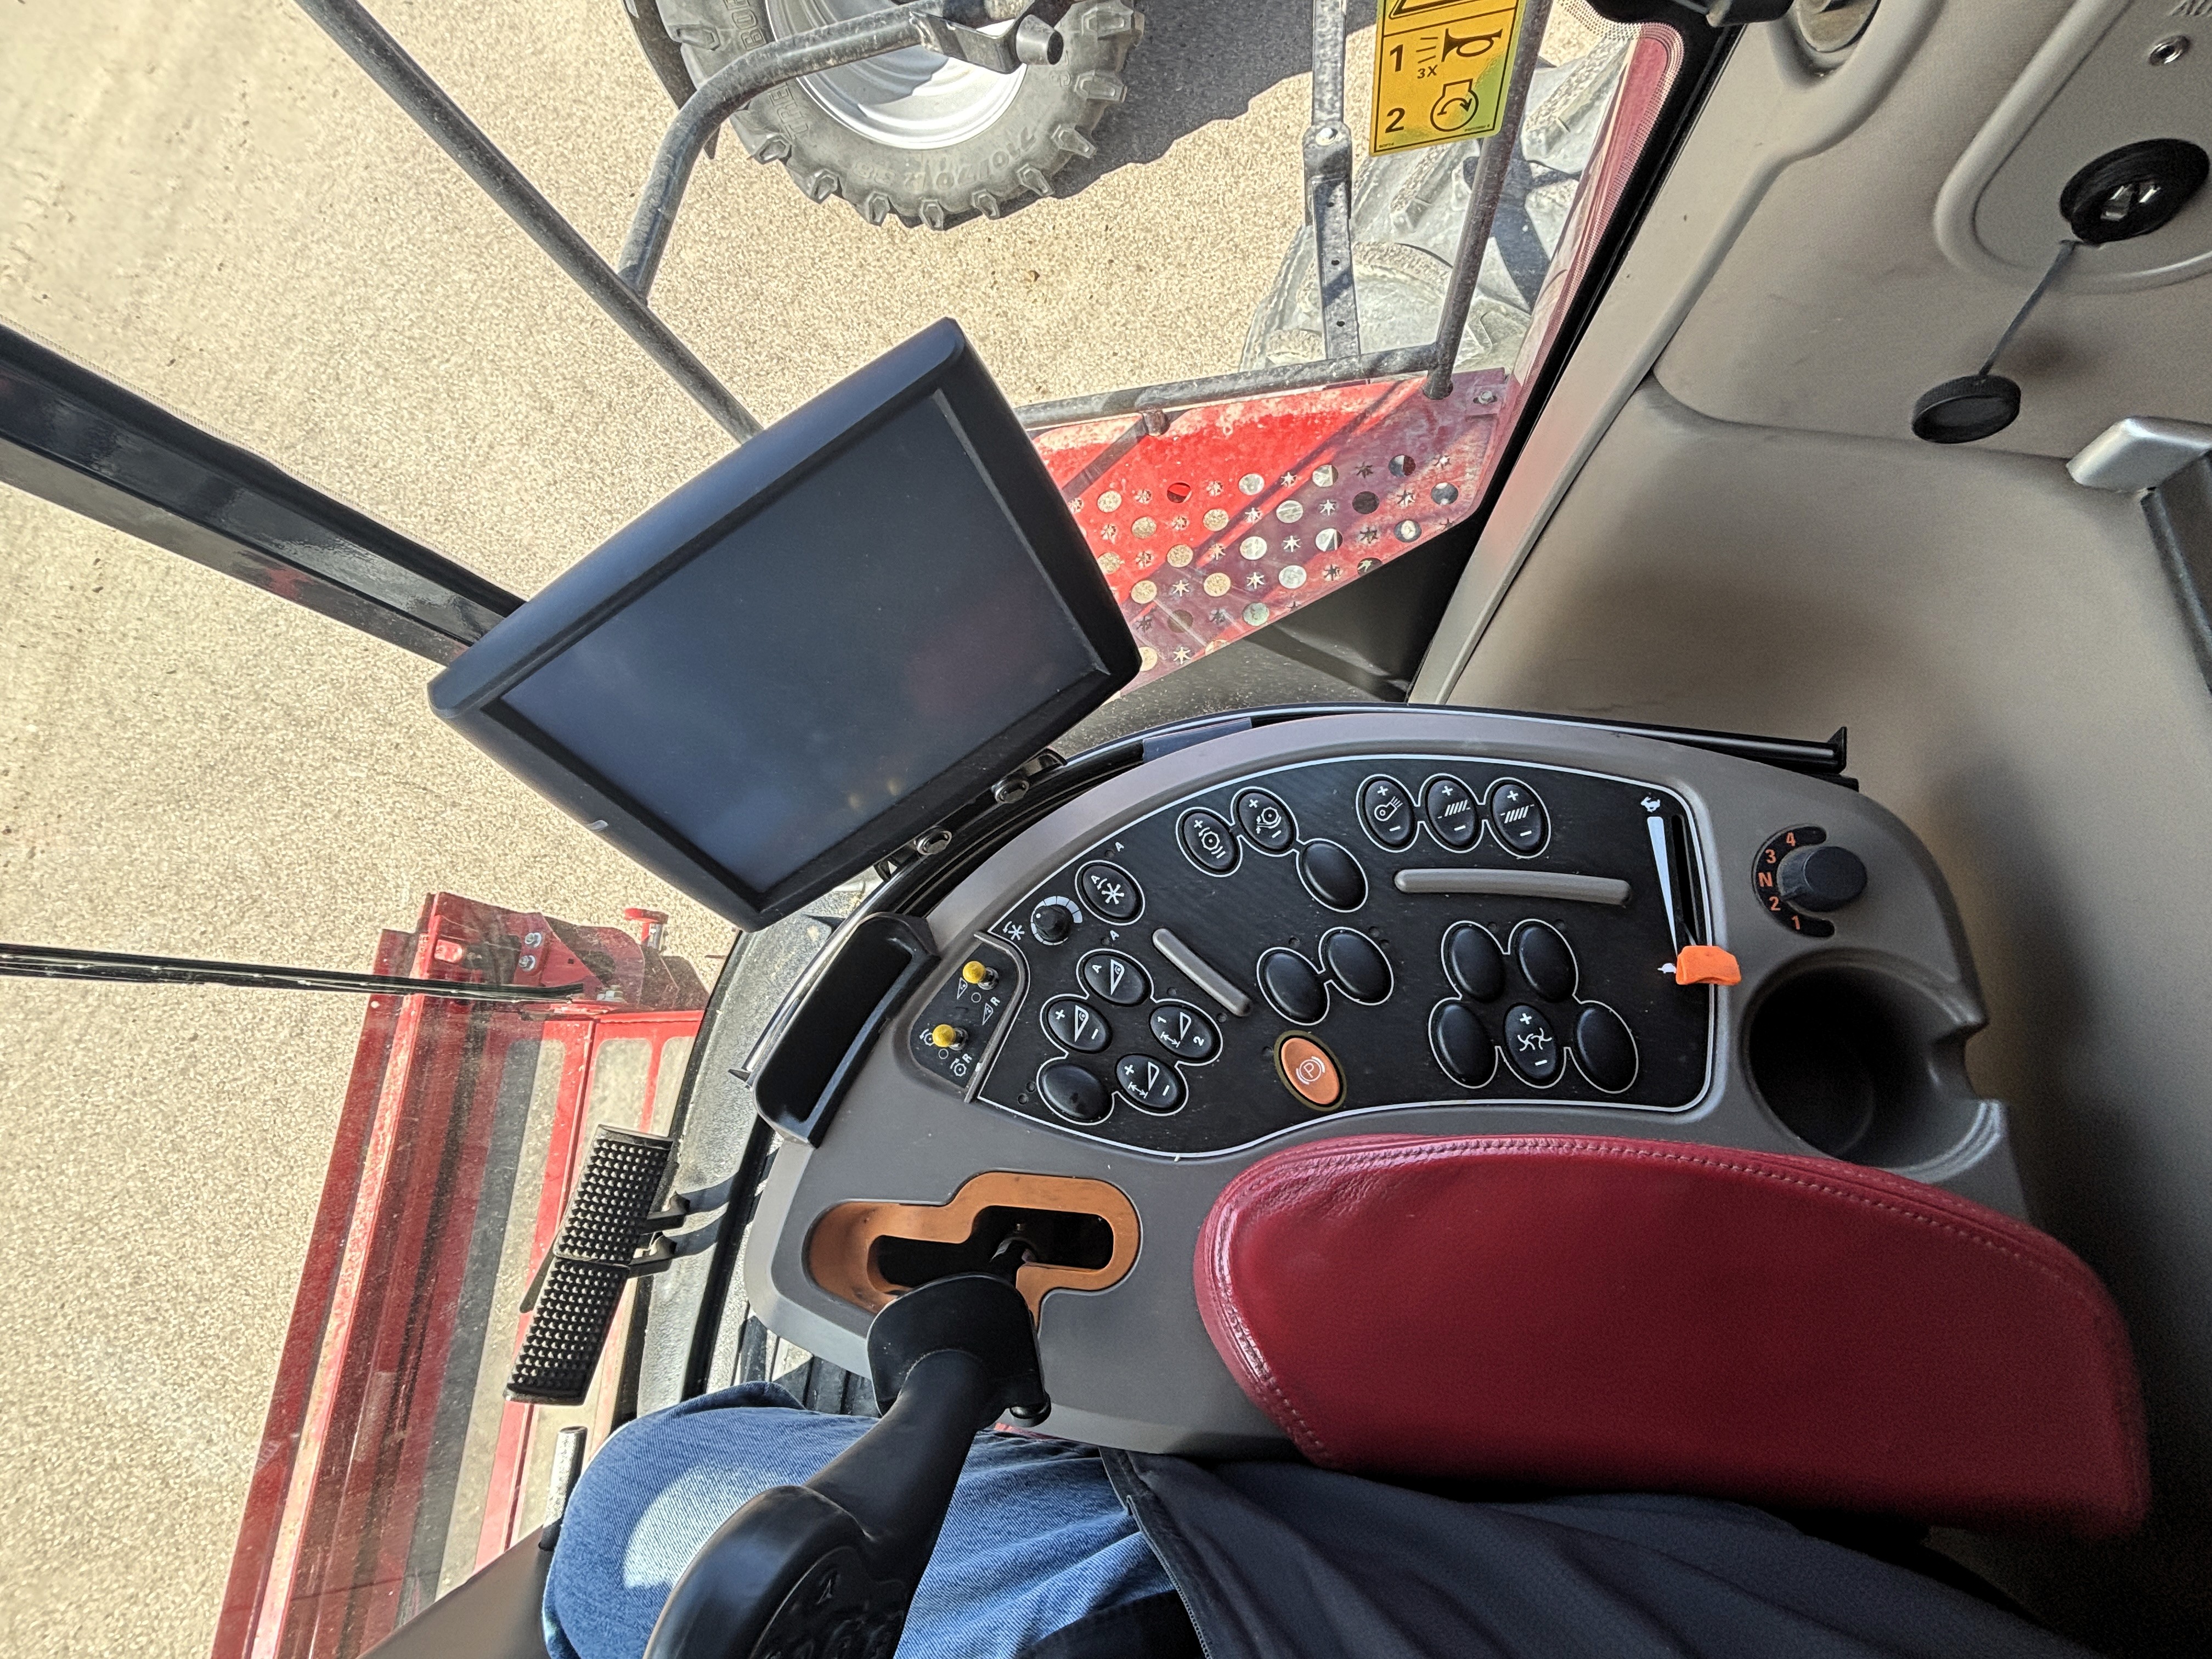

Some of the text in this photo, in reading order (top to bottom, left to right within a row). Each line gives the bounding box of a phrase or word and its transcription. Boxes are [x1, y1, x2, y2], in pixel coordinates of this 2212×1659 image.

[1390, 44, 1403, 72] 1
[1417, 65, 1438, 79] 3X
[1385, 108, 1405, 133] 2
[1786, 832, 1796, 847] 4
[1115, 842, 1125, 852] A
[1765, 849, 1776, 864] 3
[1091, 876, 1101, 884] A
[1758, 872, 1773, 887] N
[1769, 896, 1781, 911] 2
[1792, 916, 1800, 929] 1
[1110, 930, 1119, 941] A
[1092, 965, 1102, 974] A
[990, 997, 1000, 1006] R
[1193, 1036, 1204, 1046] 2
[962, 1053, 972, 1063] R
[1304, 1063, 1314, 1078] P
